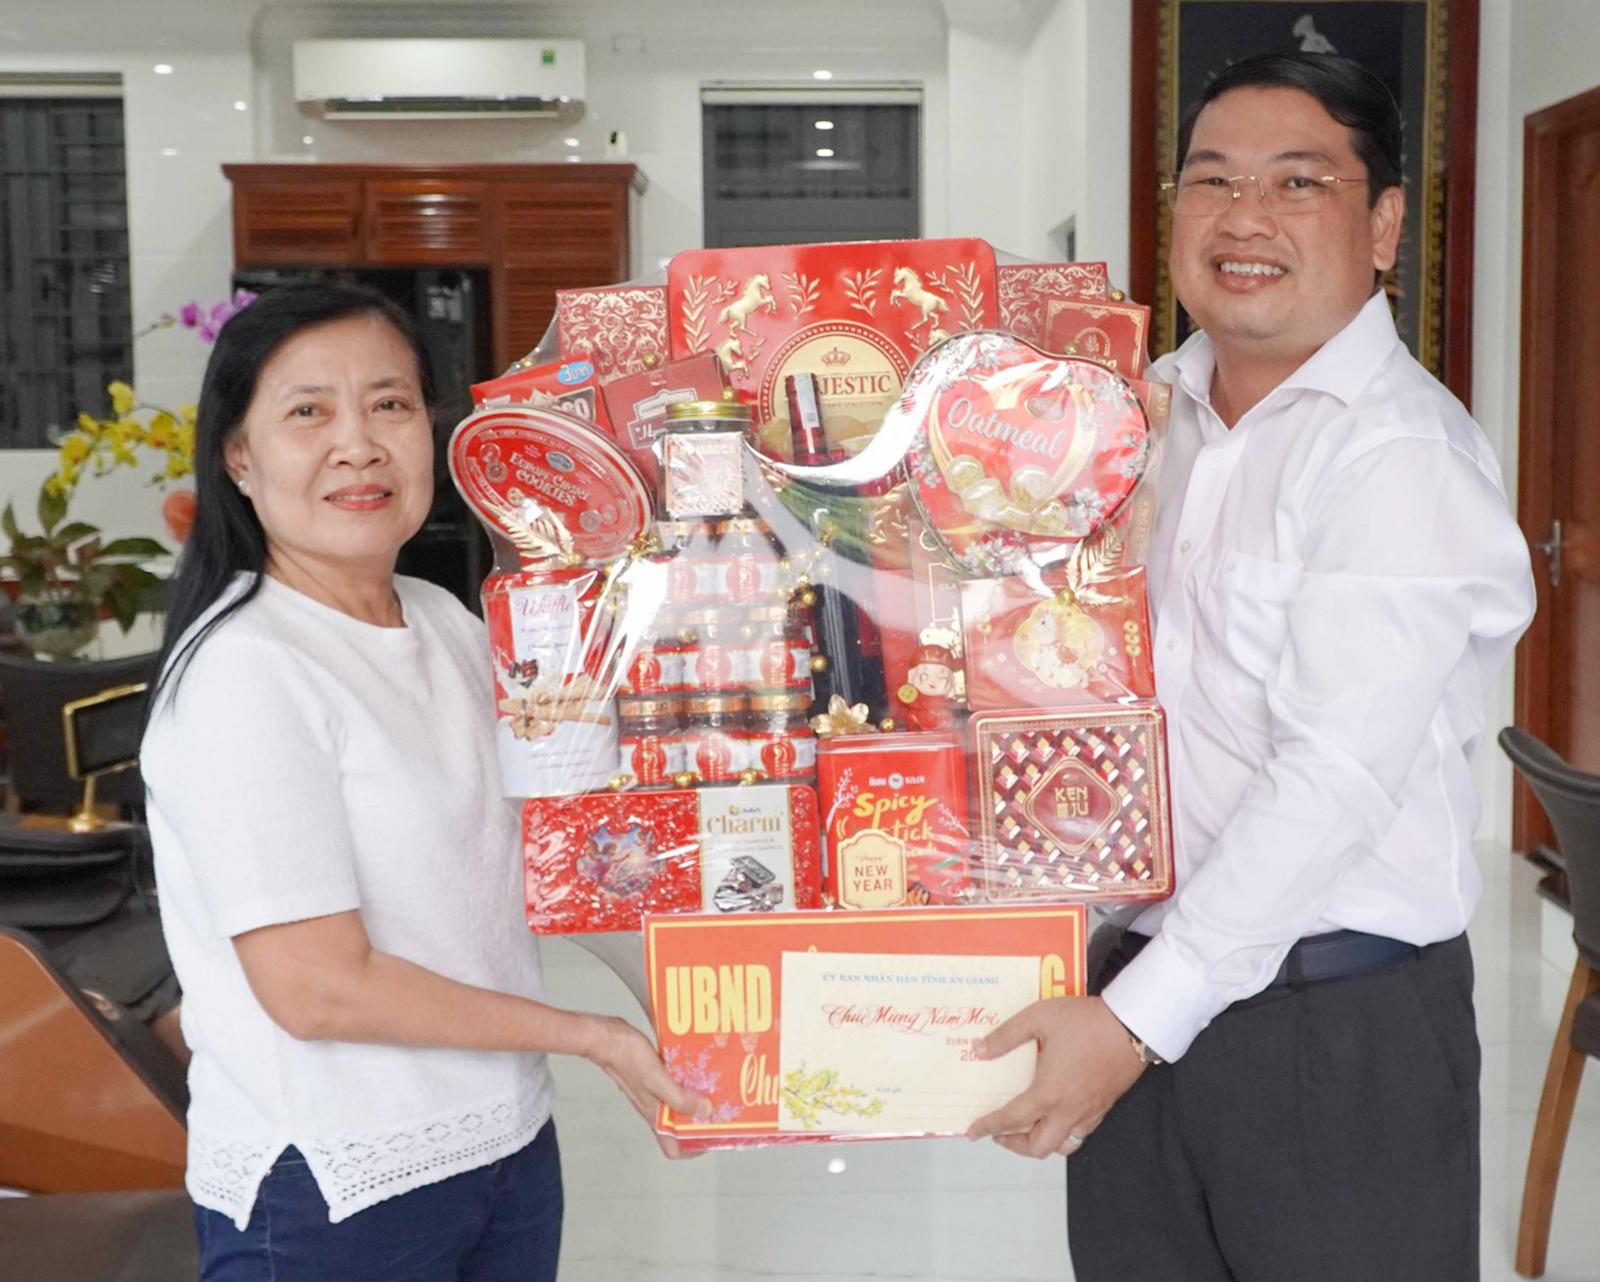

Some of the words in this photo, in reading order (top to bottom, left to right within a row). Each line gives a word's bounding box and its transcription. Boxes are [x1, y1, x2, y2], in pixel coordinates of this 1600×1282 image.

[819, 374, 892, 396] JESTIC
[947, 397, 1067, 458] Oatmeal
[515, 469, 576, 506] COOKIES
[1055, 786, 1088, 802] KEN
[853, 792, 939, 830] Spicy
[1070, 801, 1089, 818] JU
[706, 815, 781, 837] Charm
[854, 865, 889, 878] NEW
[853, 879, 894, 893] YEAR
[949, 975, 963, 984] AN
[966, 975, 999, 985] GIANG
[665, 964, 773, 1036] UBND
